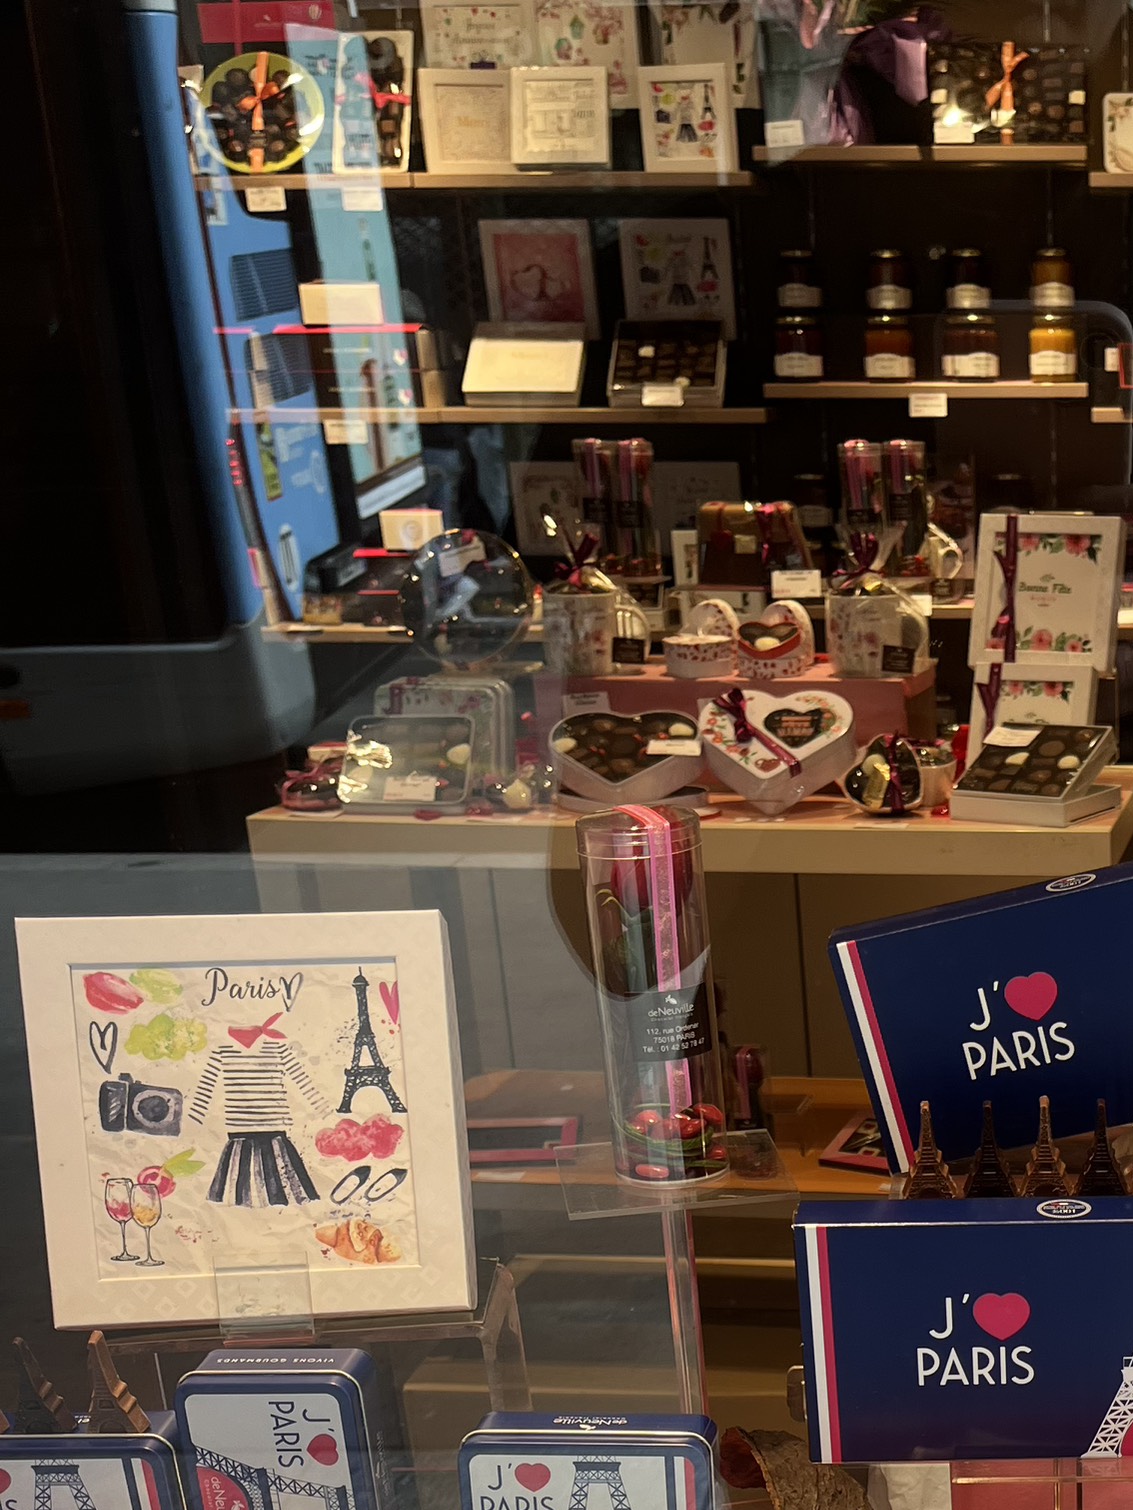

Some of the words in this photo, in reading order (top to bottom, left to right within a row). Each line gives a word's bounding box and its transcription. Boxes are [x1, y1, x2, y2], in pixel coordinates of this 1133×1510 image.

[201, 967, 279, 1006] Paris
[653, 1035, 675, 1043] 75018
[676, 1031, 696, 1041] PARIS
[671, 1043, 680, 1051] 42
[962, 1021, 1075, 1081] PARIS
[916, 1345, 1035, 1387] PARIS
[268, 1401, 304, 1468] PARIS
